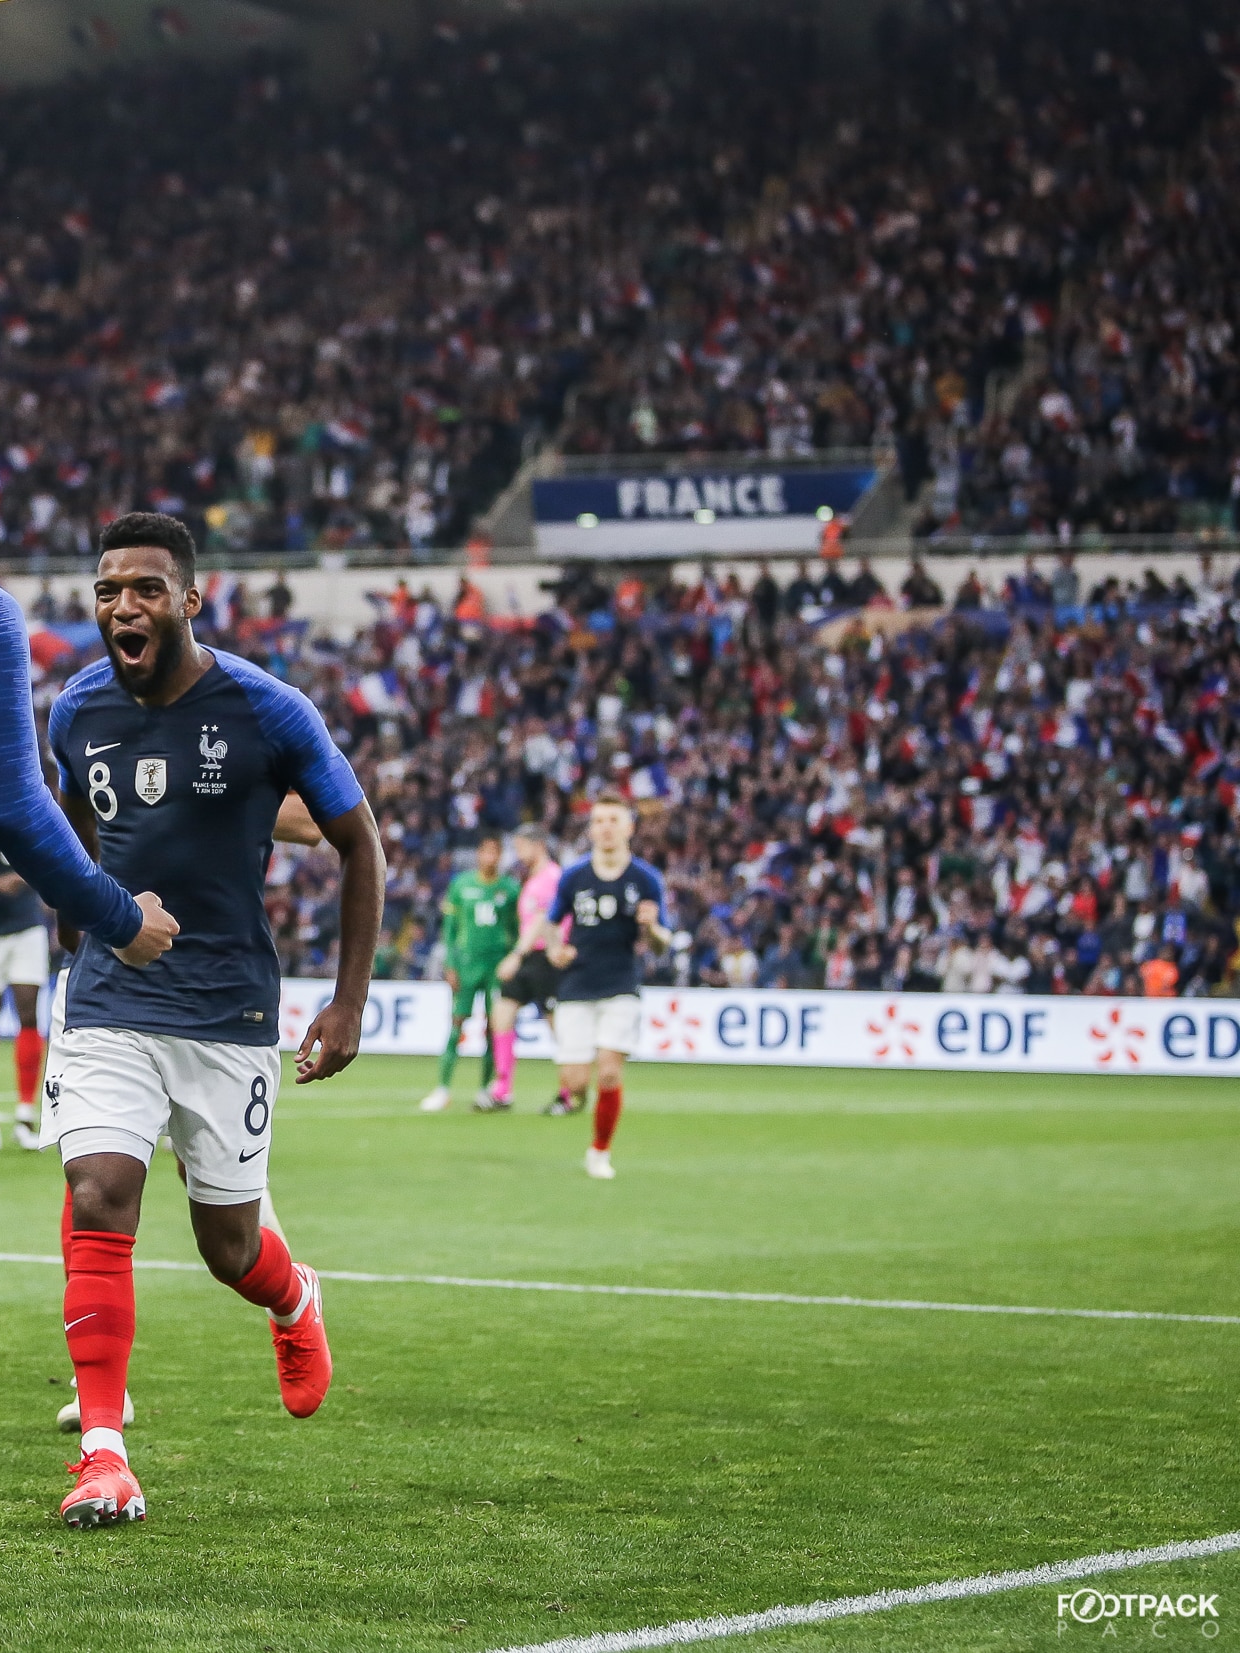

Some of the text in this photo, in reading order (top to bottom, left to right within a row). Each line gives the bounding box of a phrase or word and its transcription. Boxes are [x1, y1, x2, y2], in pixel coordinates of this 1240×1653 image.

[617, 474, 786, 517] FRANCE
[88, 761, 118, 822] 8
[1162, 1014, 1240, 1060] eD
[244, 1075, 269, 1137] 8
